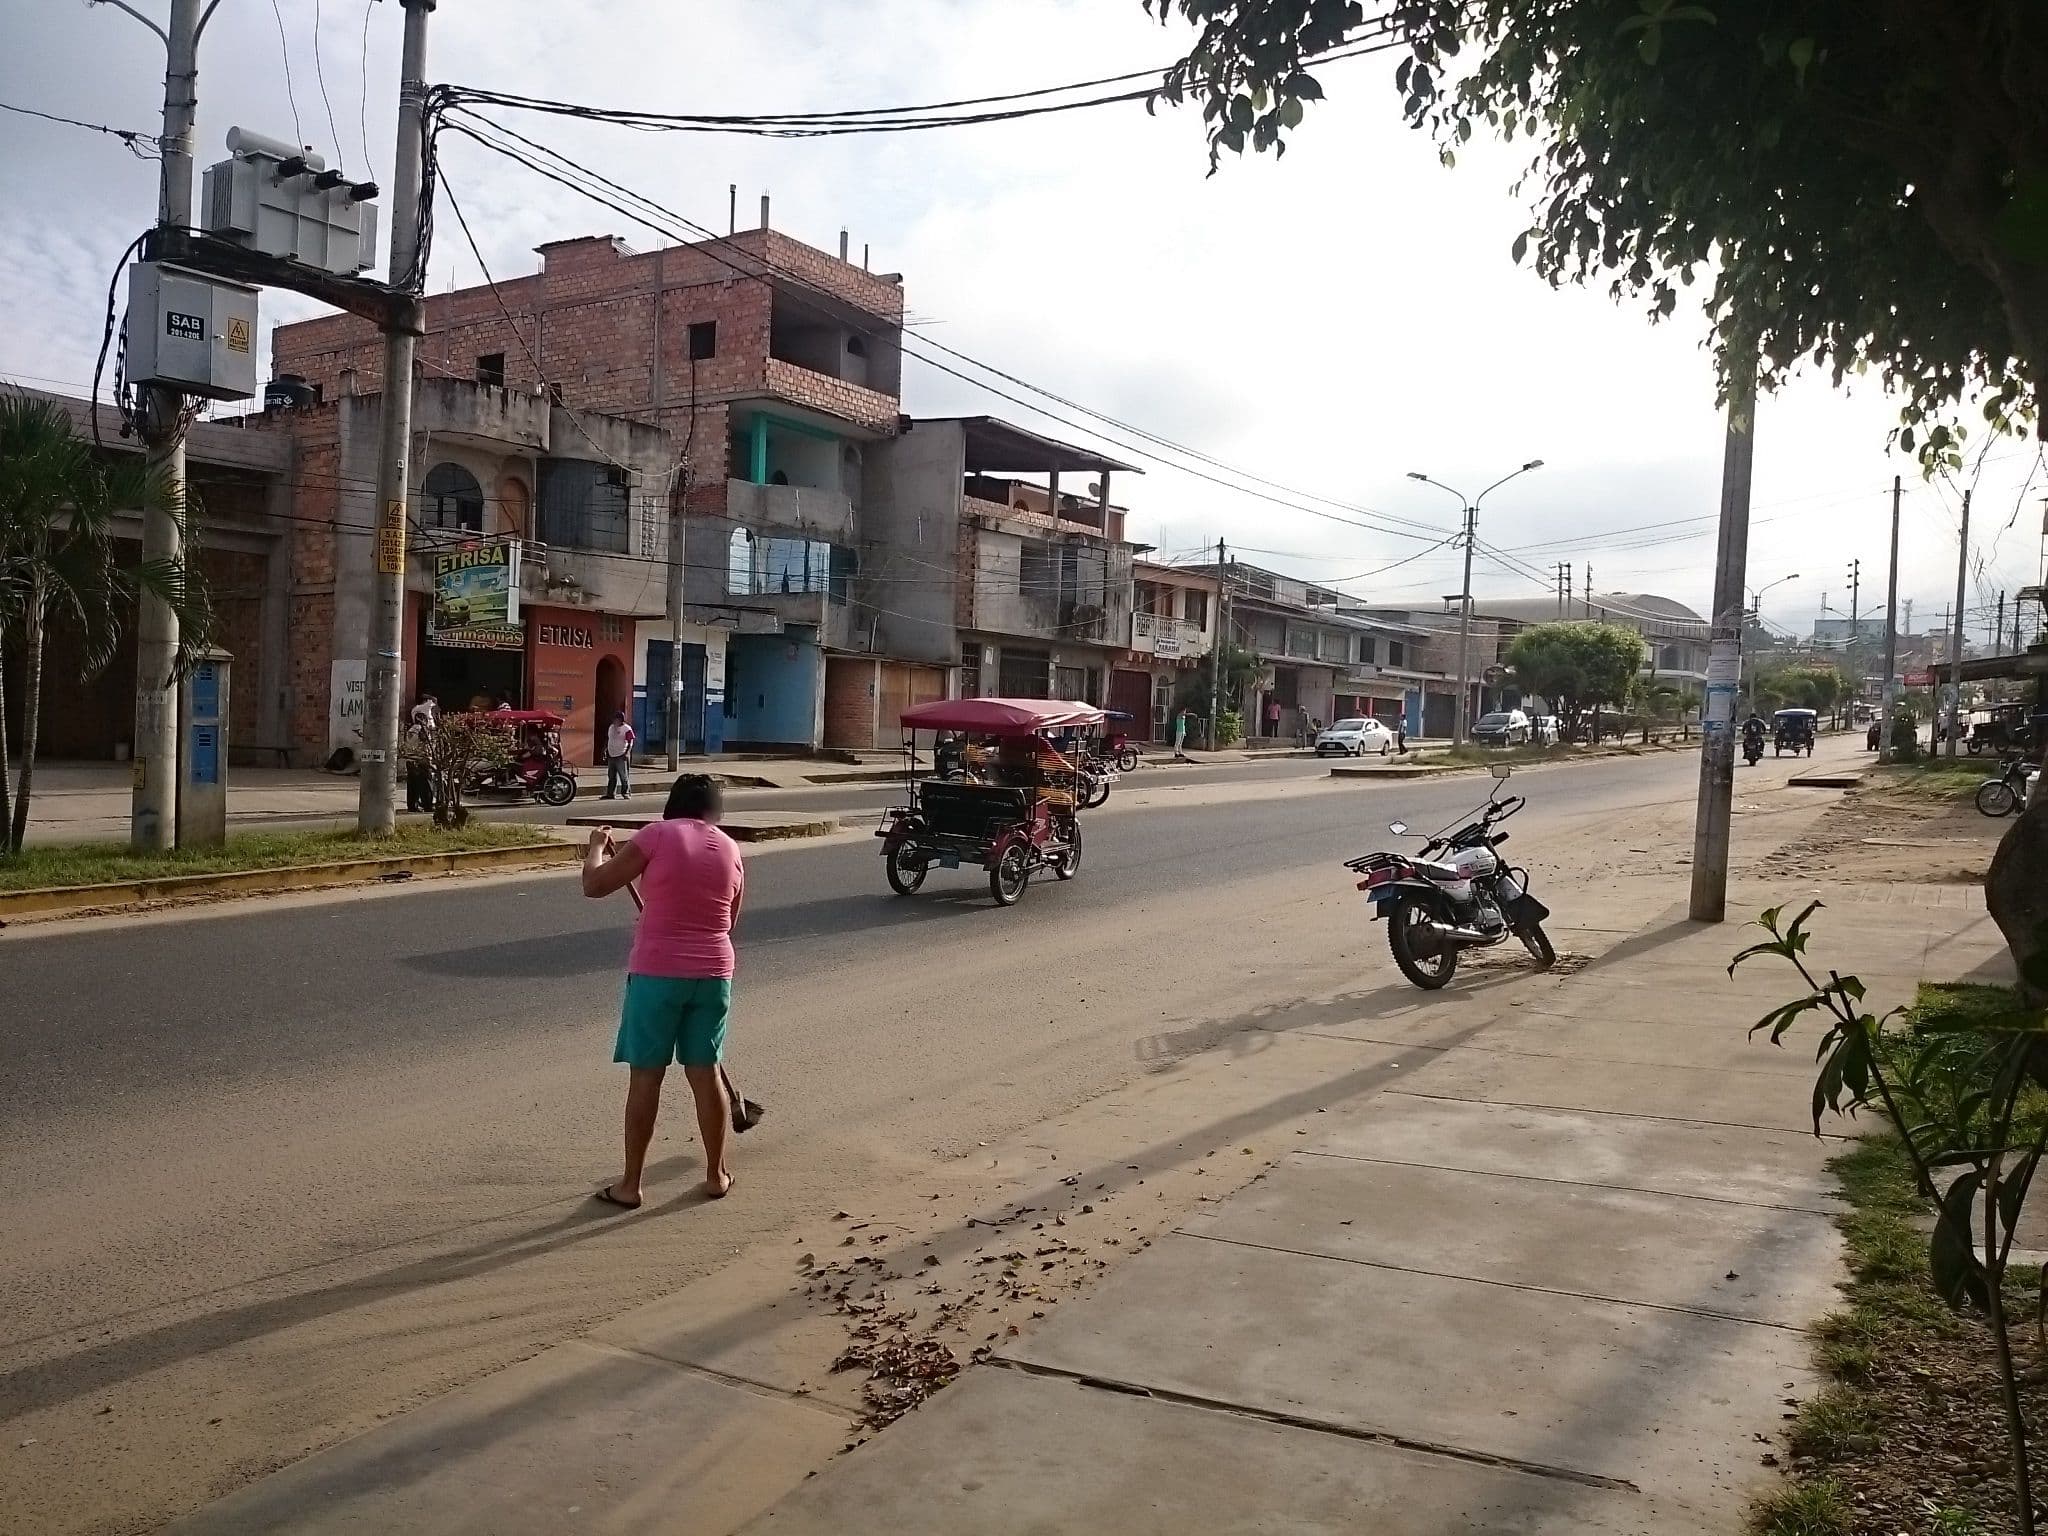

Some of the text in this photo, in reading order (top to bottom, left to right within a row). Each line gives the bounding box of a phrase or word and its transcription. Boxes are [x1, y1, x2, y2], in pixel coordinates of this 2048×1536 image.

[171, 314, 201, 330] SAB
[438, 546, 504, 575] ETRISA
[538, 624, 593, 650] ETRISA
[341, 698, 363, 718] LAM
